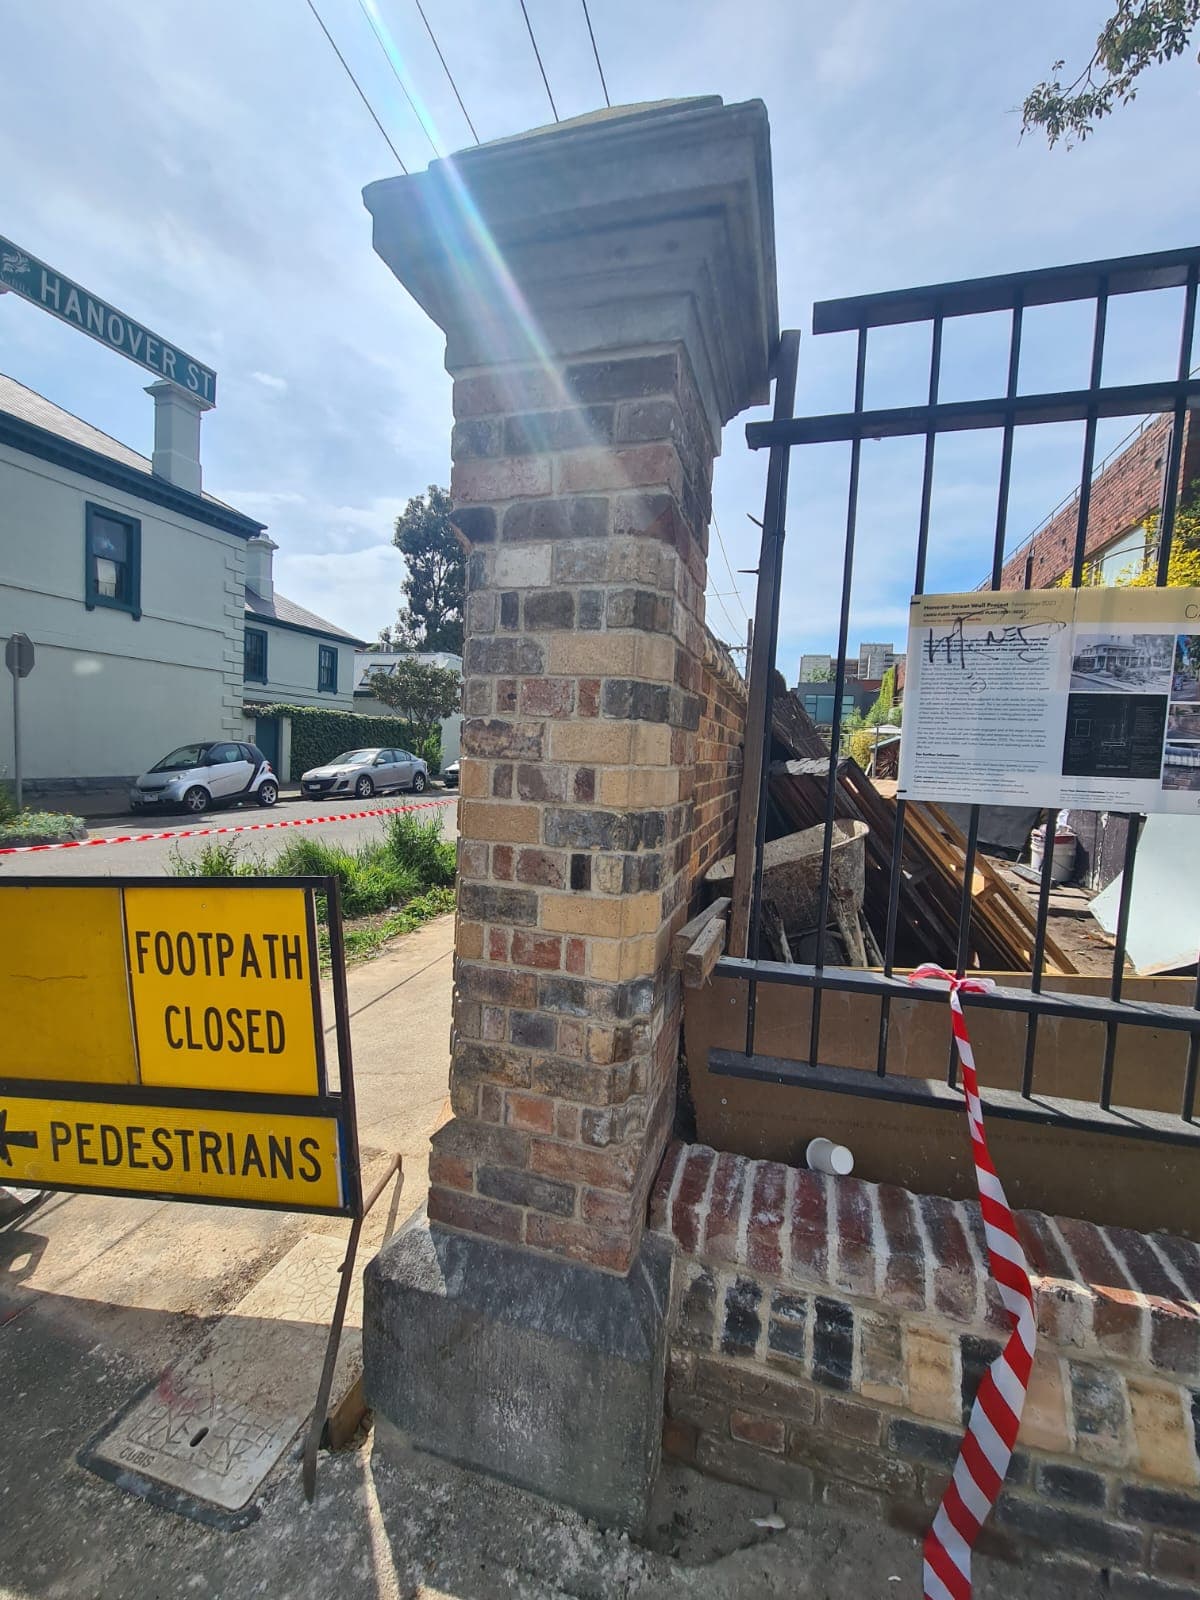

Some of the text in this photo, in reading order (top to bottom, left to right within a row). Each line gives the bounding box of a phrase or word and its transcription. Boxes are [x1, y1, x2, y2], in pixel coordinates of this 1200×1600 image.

[40, 270, 213, 398] HANOVER ST
[1185, 604, 1200, 619] C
[135, 930, 304, 980] FOOTPATH
[164, 1005, 286, 1054] CLOSED
[50, 1120, 322, 1183] PEDESTRIANS
[119, 1447, 155, 1468] CUBIS
